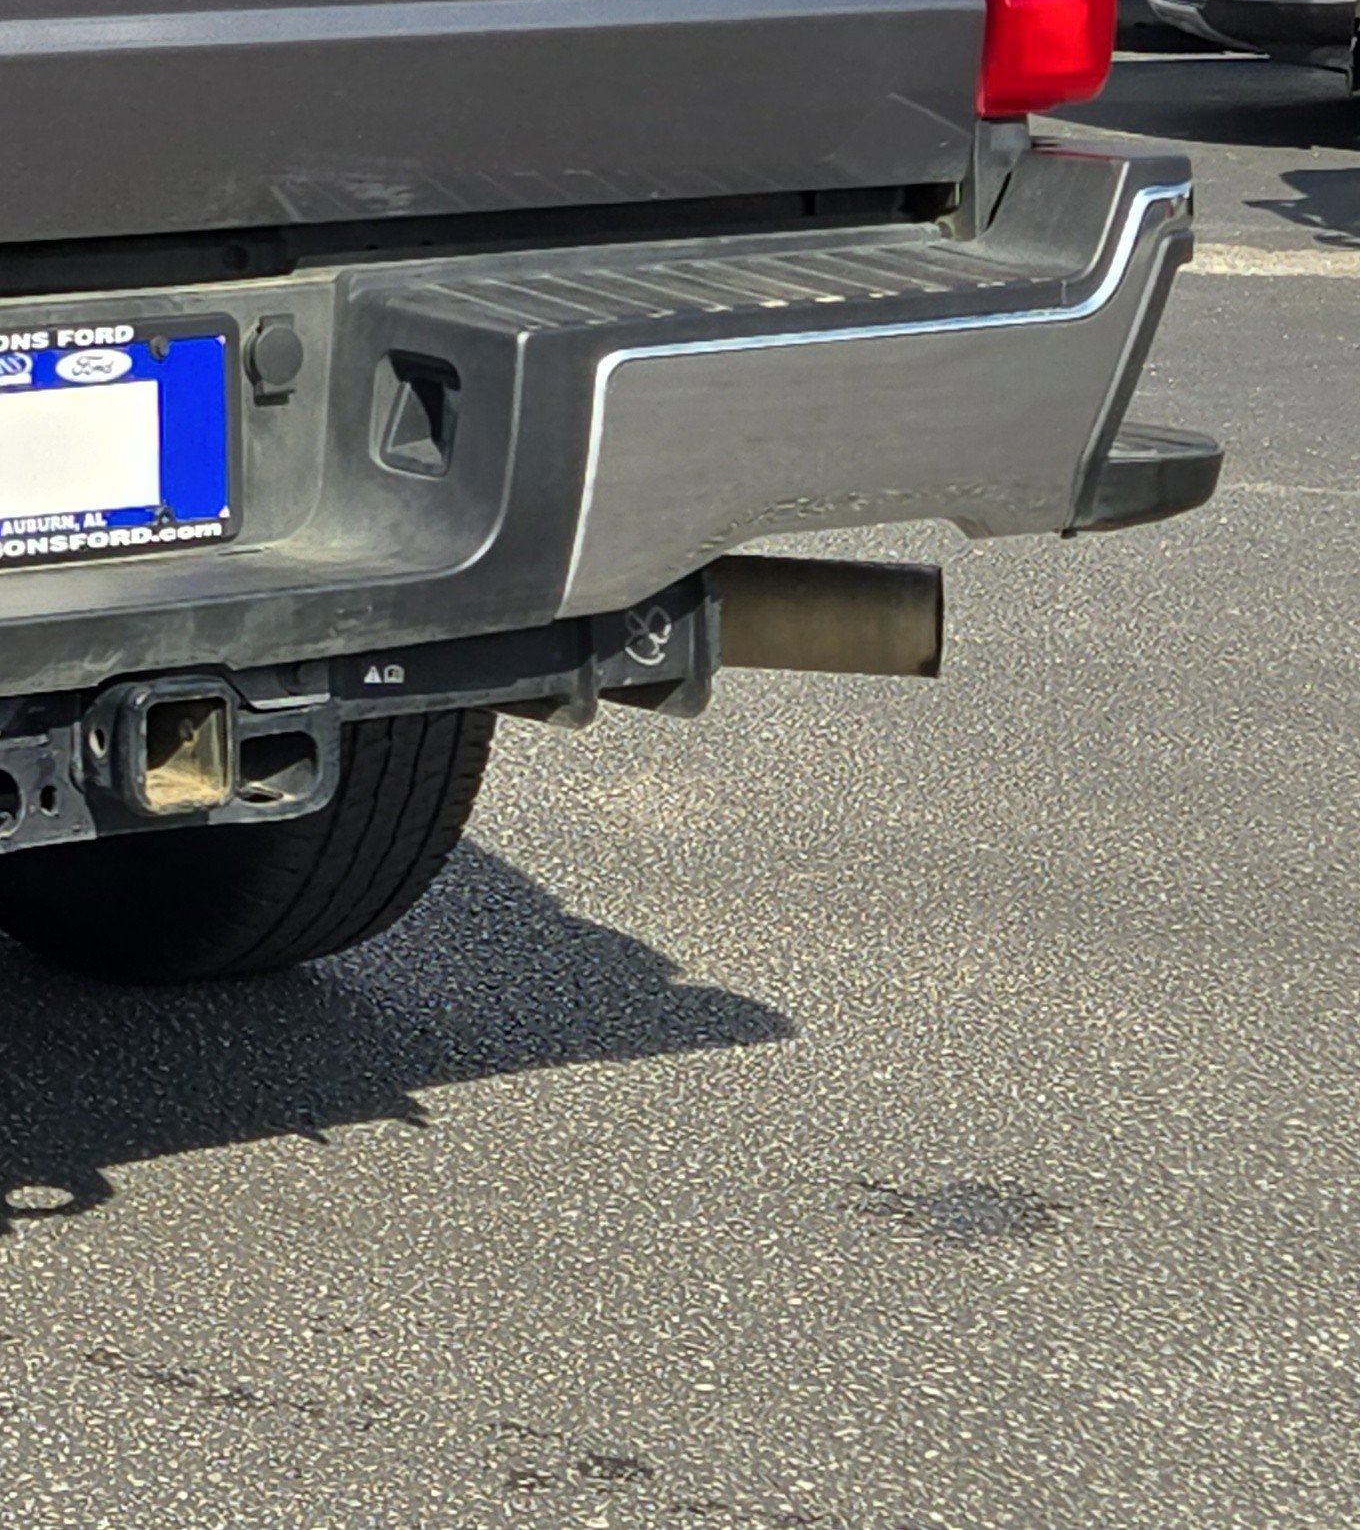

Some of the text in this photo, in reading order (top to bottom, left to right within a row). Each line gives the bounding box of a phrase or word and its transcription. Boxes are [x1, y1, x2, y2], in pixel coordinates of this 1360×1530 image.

[57, 325, 135, 347] FORD
[0, 512, 108, 537] AUBURN, AL
